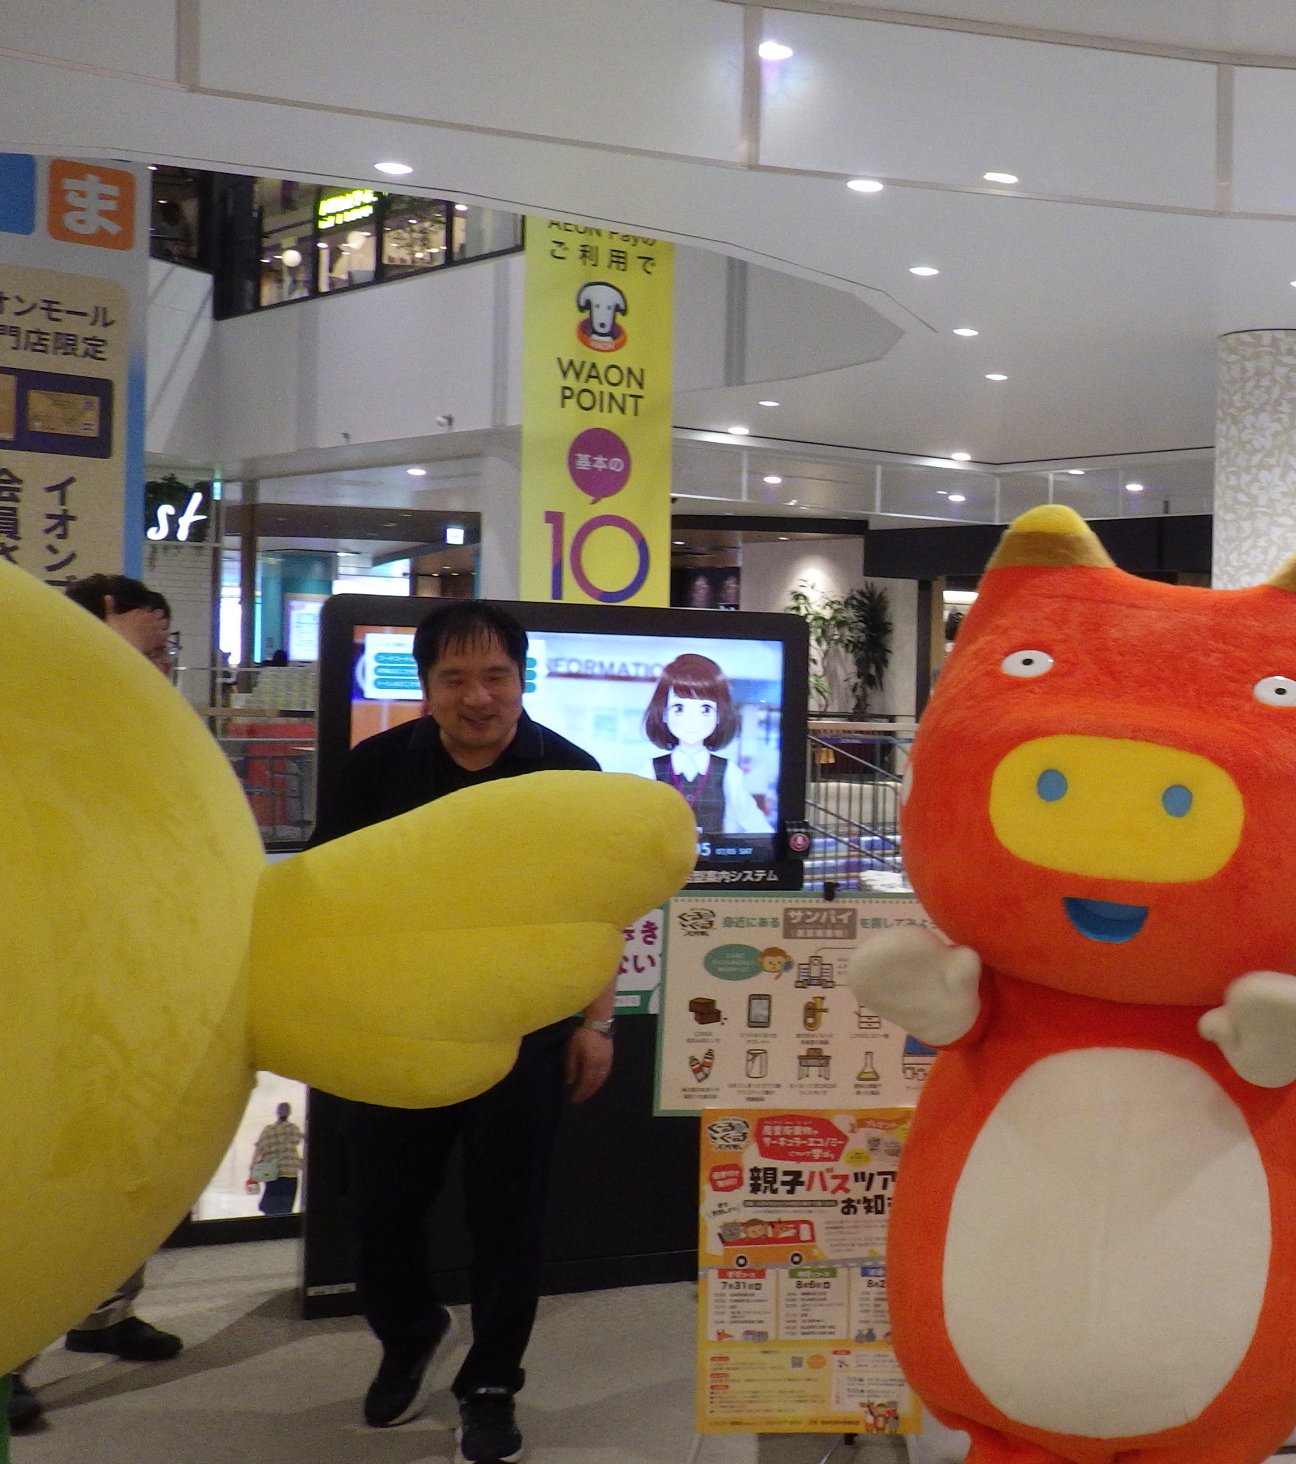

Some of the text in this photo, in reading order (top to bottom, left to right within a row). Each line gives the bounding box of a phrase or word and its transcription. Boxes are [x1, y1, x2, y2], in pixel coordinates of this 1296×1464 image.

[61, 172, 122, 236] ま
[550, 239, 656, 275] ご利用で
[557, 356, 645, 390] WAON
[559, 385, 644, 416] POINT
[575, 453, 624, 472] 基本の
[544, 511, 650, 604] 10
[788, 909, 853, 924] サンパイ
